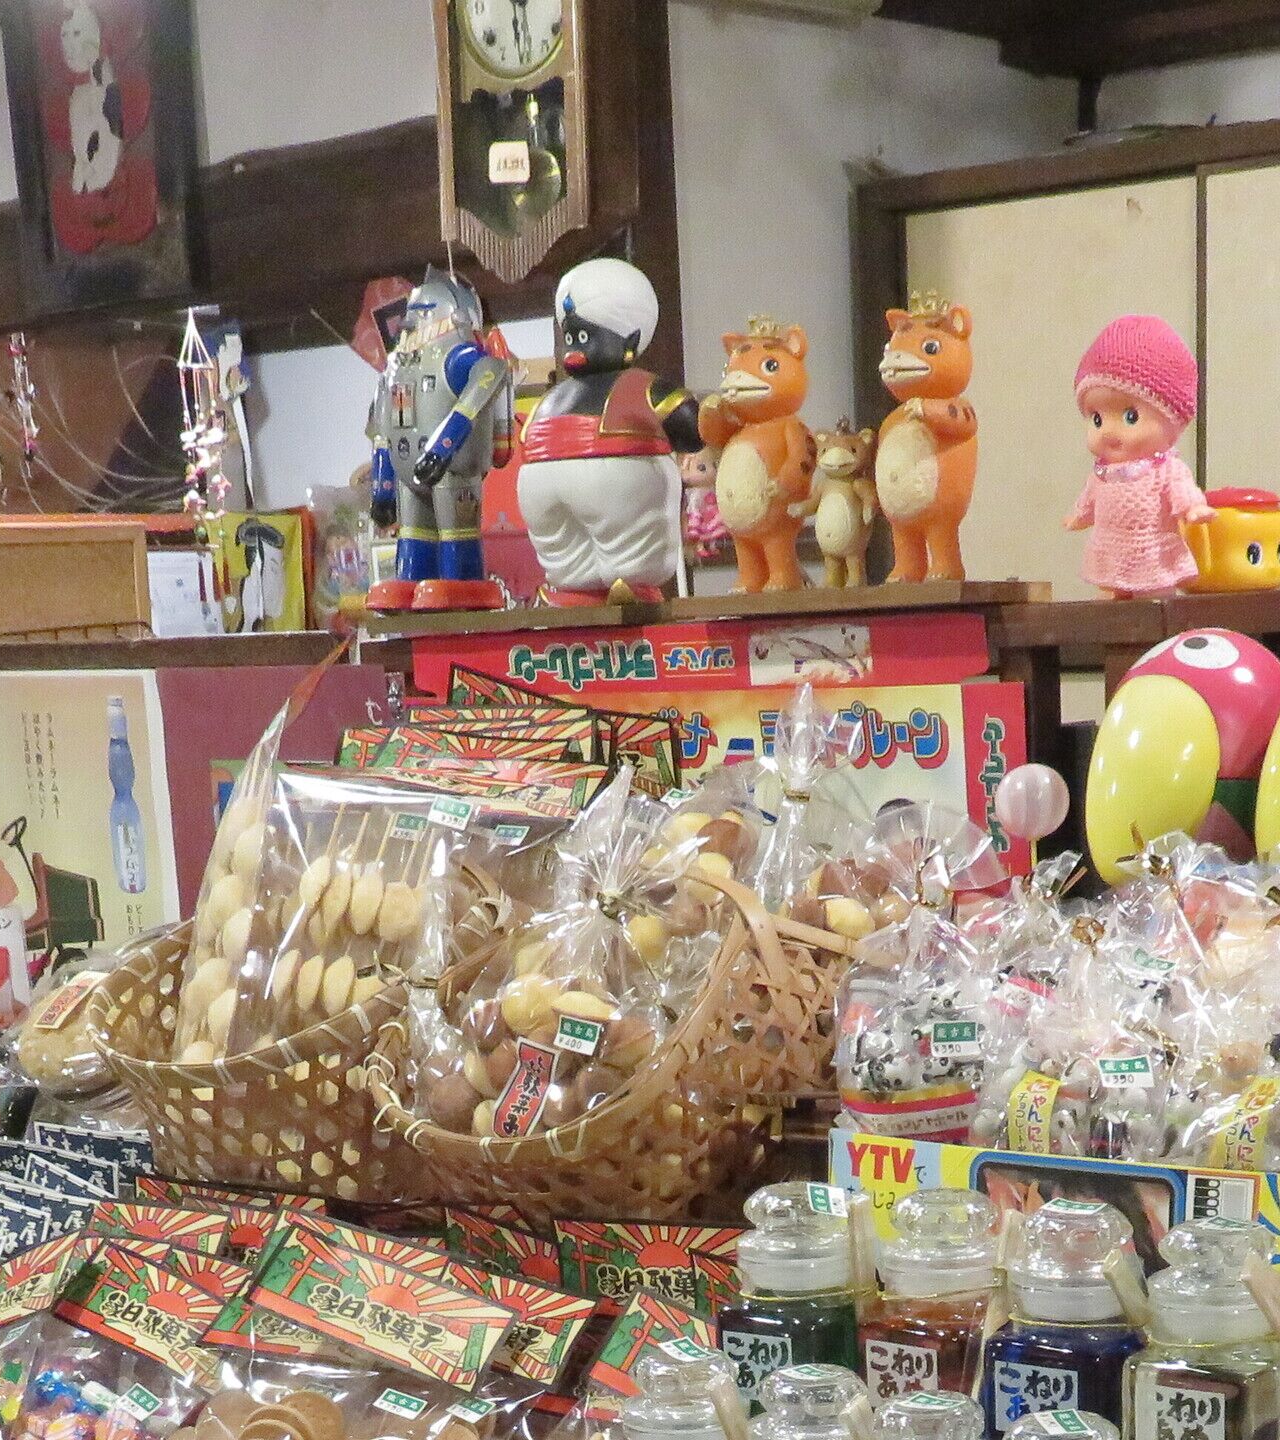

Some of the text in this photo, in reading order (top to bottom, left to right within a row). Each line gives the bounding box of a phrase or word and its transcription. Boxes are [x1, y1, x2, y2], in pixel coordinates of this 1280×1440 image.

[510, 639, 735, 690] ツバメ ライトプレーン
[307, 1282, 448, 1350] 縁日駄菓子
[727, 1335, 791, 1368] こねり
[869, 1343, 936, 1380] こねり
[999, 1366, 1075, 1402] こねり
[1157, 1391, 1223, 1426] ねり
